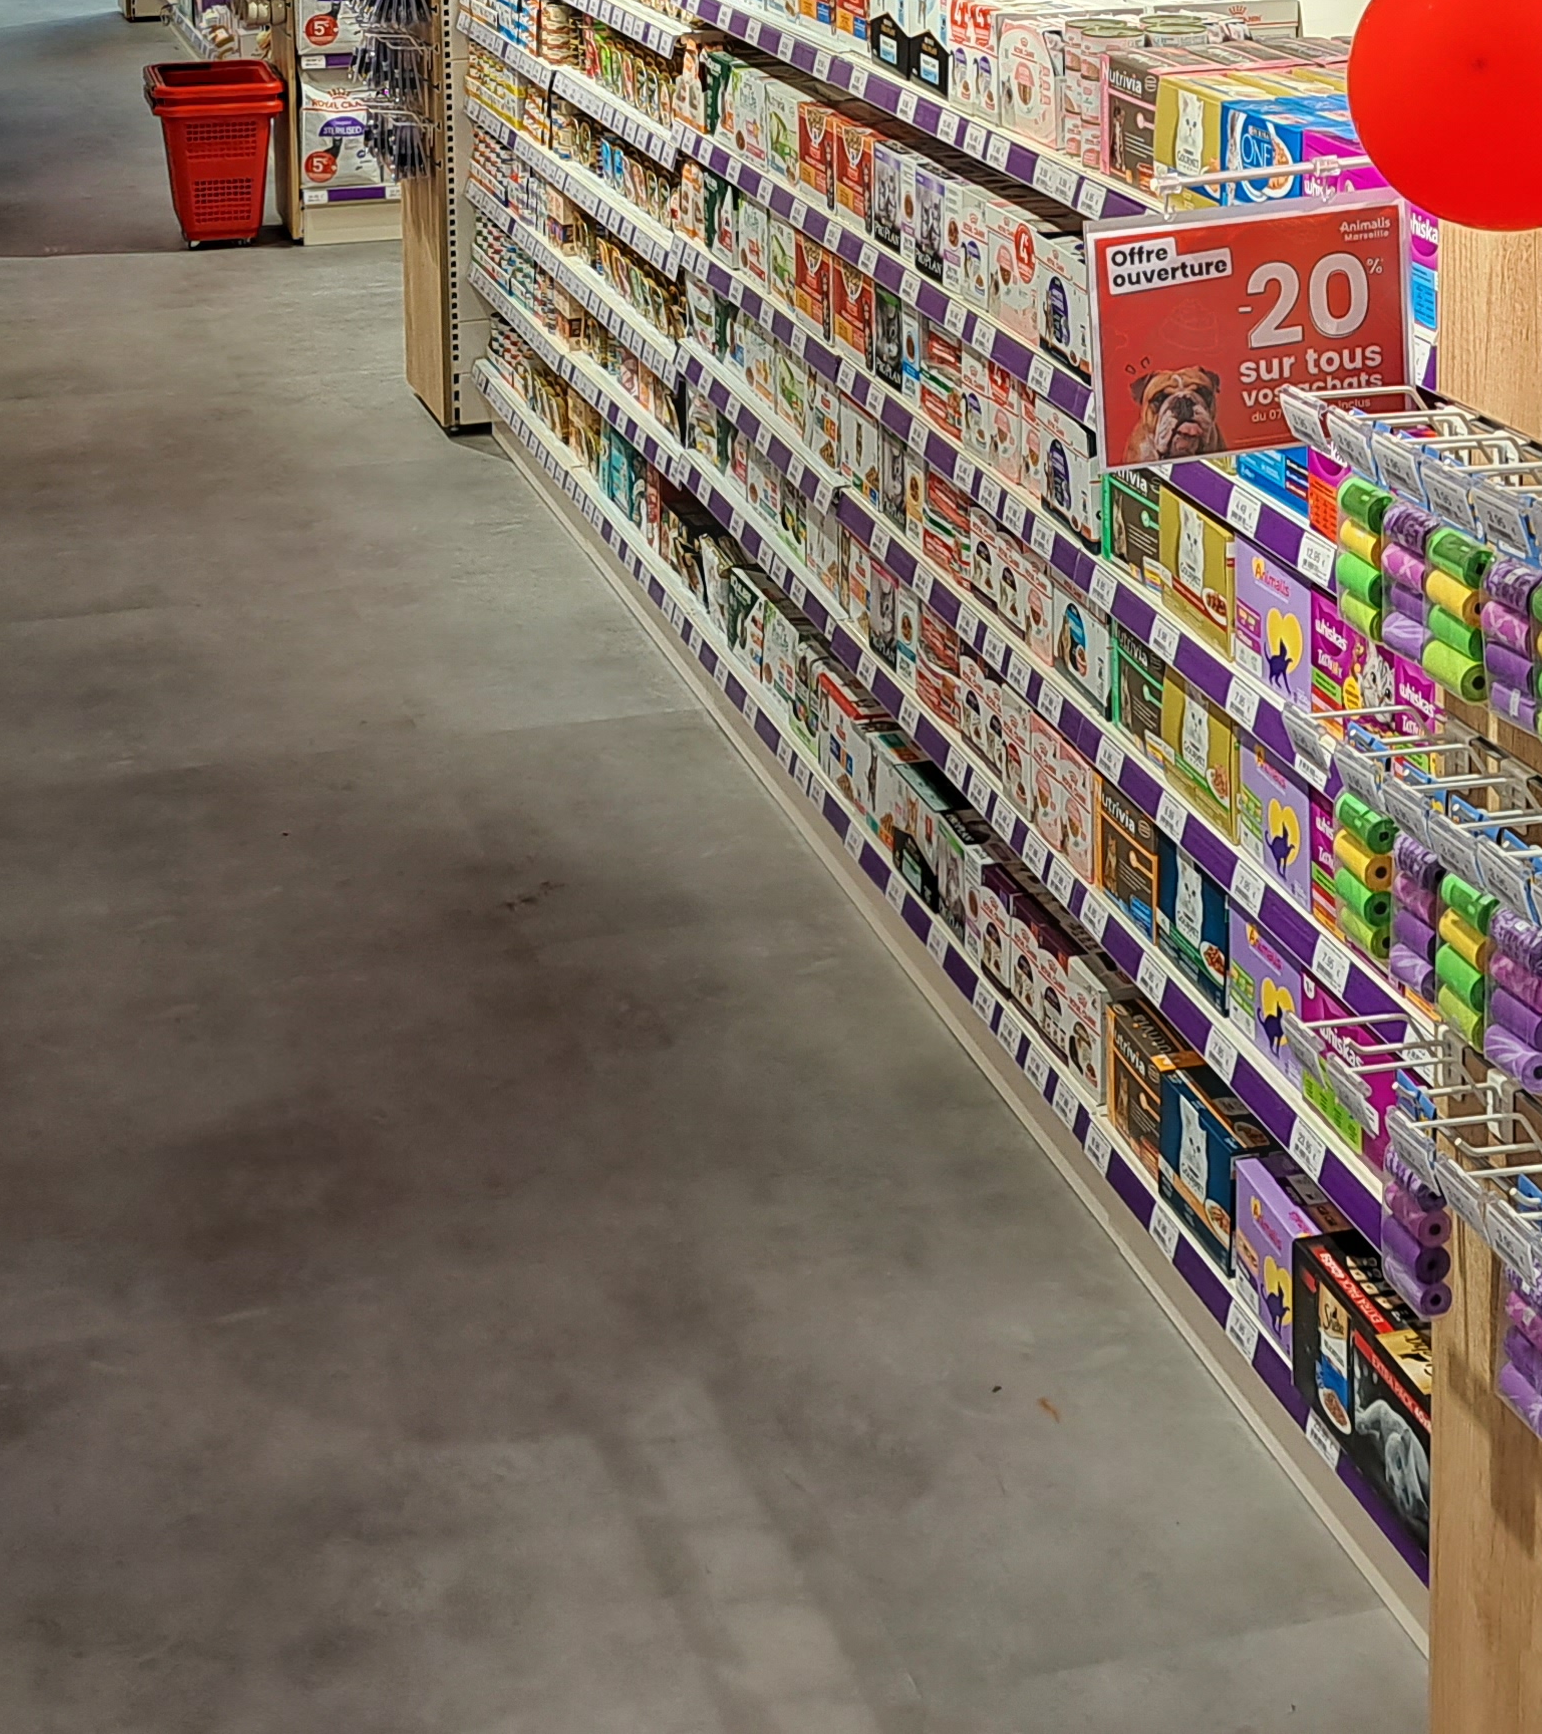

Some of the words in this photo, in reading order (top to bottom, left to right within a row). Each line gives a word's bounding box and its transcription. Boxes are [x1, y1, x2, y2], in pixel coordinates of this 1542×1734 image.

[1339, 217, 1391, 235] Animalis
[1344, 229, 1389, 242] Marseille
[1111, 245, 1168, 267] Offre
[1113, 258, 1227, 288] ouverture
[1239, 355, 1296, 384] sur
[1305, 344, 1382, 375] tous
[1252, 411, 1267, 422] du
